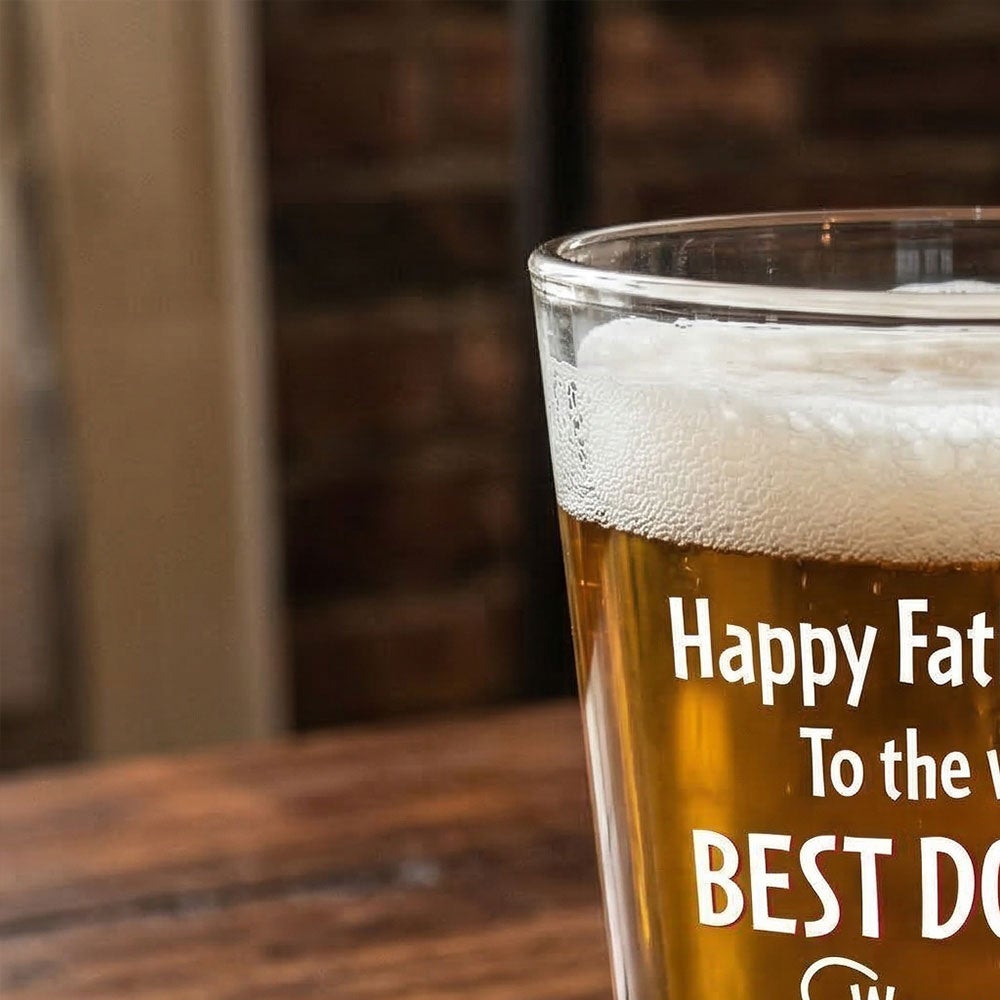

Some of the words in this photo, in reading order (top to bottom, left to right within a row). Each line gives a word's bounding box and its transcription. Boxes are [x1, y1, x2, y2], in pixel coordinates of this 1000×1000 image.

[668, 596, 878, 708] Happy
[799, 726, 864, 798] To
[879, 727, 972, 801] the
[692, 829, 896, 939] BEST
